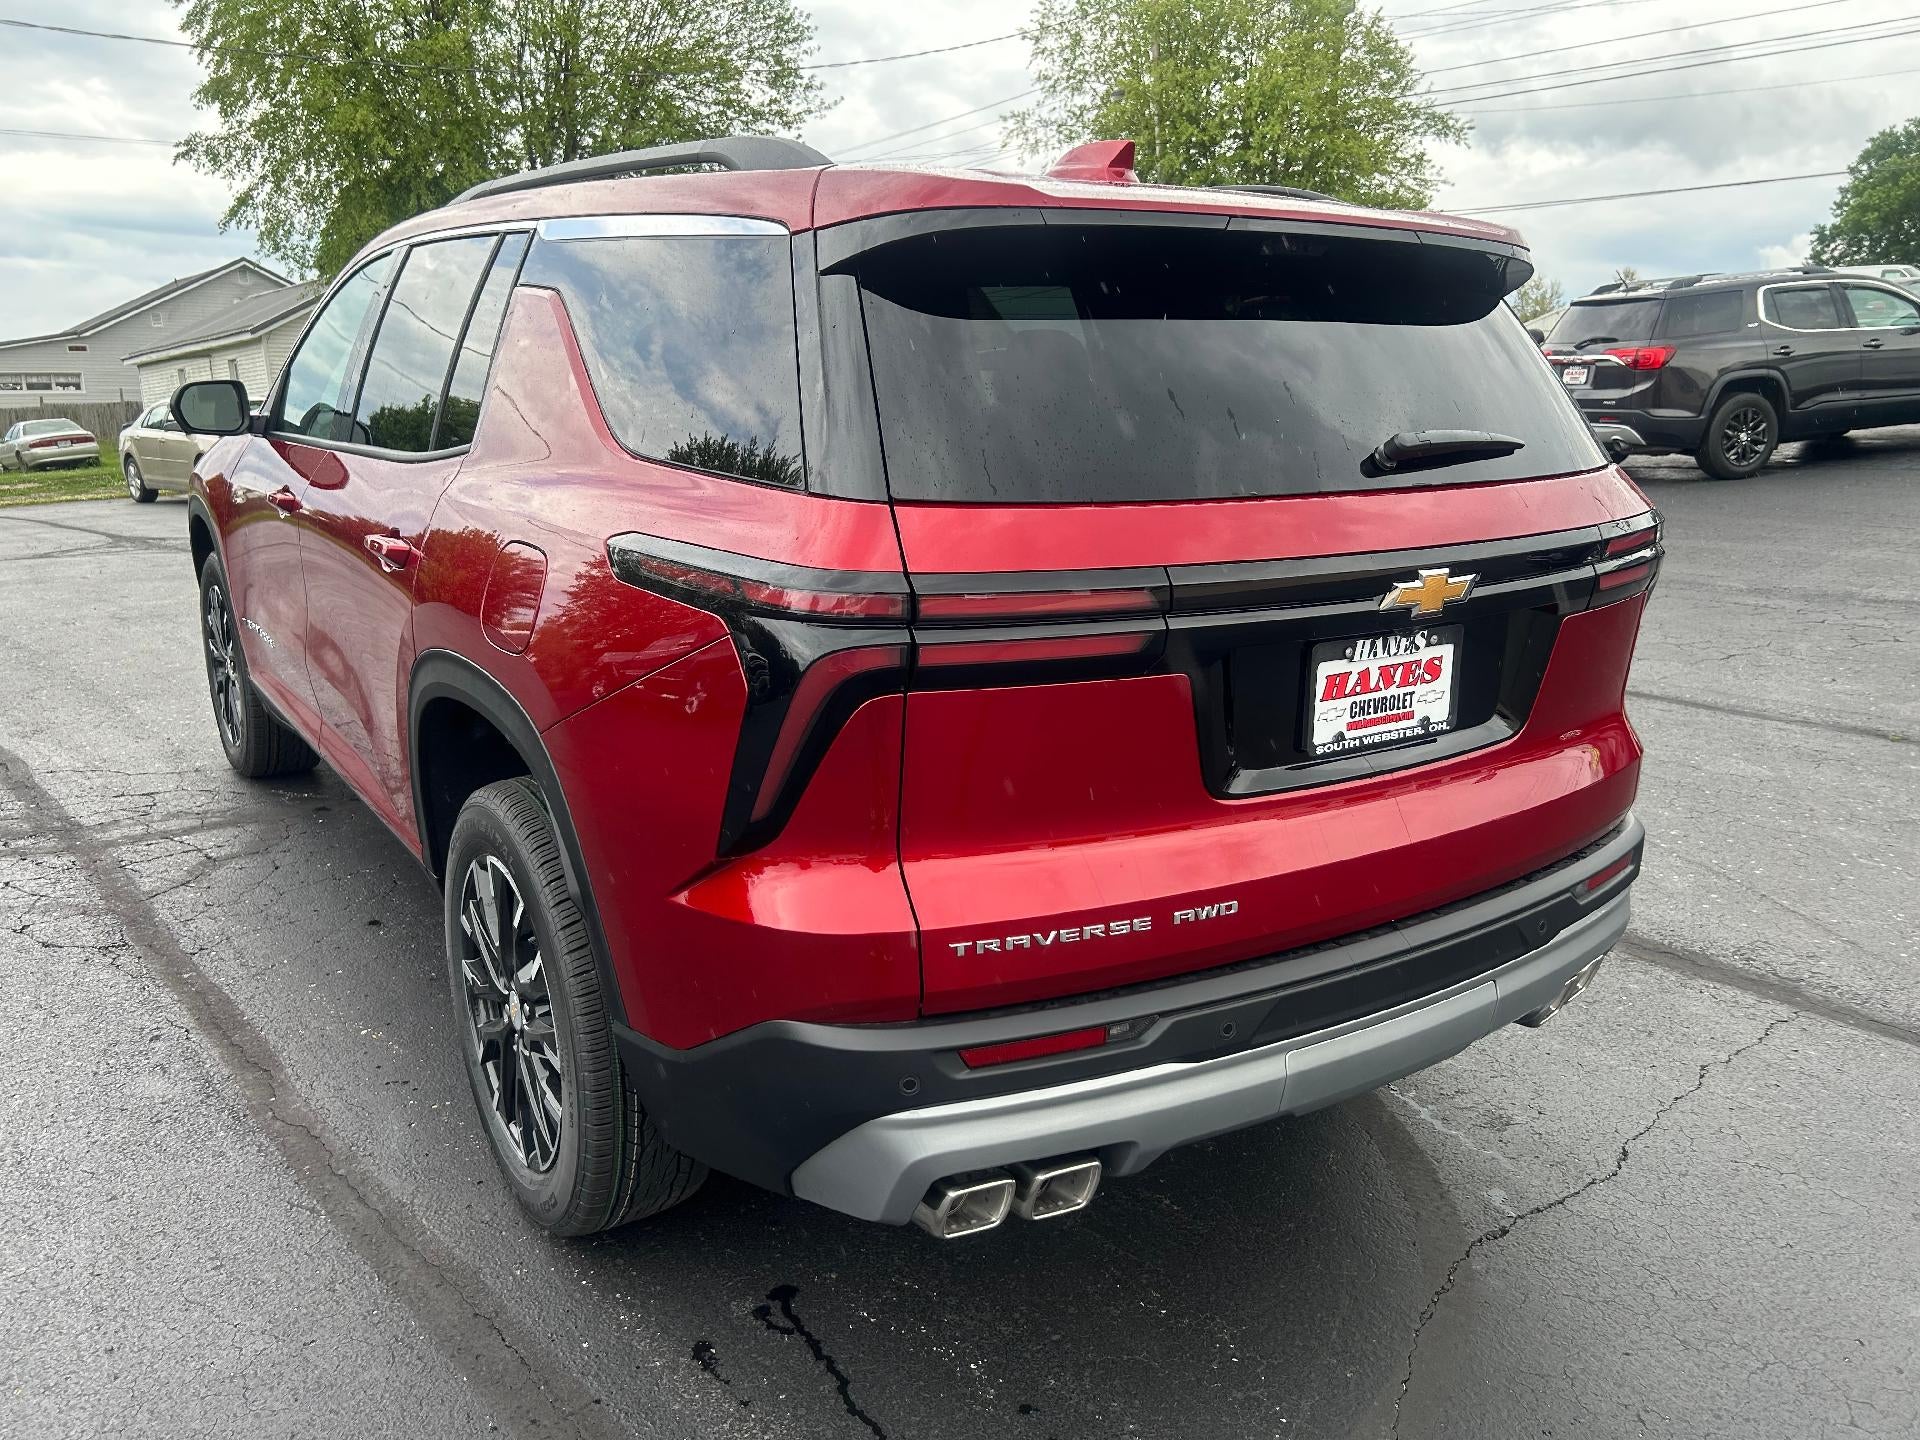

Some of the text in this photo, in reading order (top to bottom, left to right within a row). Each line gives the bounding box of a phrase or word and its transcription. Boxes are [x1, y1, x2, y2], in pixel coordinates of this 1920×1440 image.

[1354, 630, 1428, 662] HANES
[1320, 655, 1443, 702] HANES
[1350, 692, 1415, 719] CHEVROLET
[1315, 739, 1360, 755] SOUTH
[1429, 722, 1450, 733] OH.
[949, 900, 1239, 957] TRAVERSE AWD
